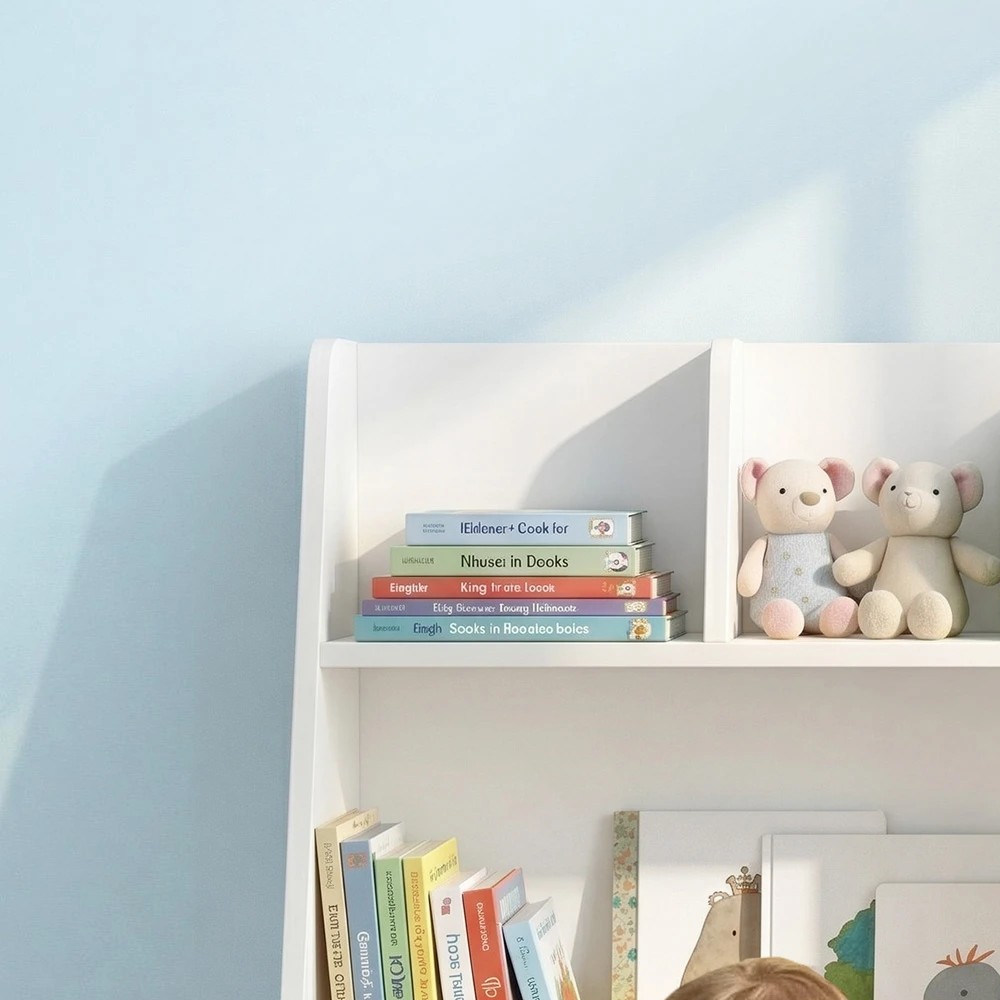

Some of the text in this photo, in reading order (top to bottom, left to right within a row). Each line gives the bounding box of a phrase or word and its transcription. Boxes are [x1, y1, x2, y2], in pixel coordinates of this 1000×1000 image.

[517, 521, 549, 535] Cook
[510, 554, 522, 568] in
[526, 554, 569, 568] Dooks
[460, 581, 487, 596] King
[449, 622, 486, 635] Sooks
[489, 622, 501, 635] in
